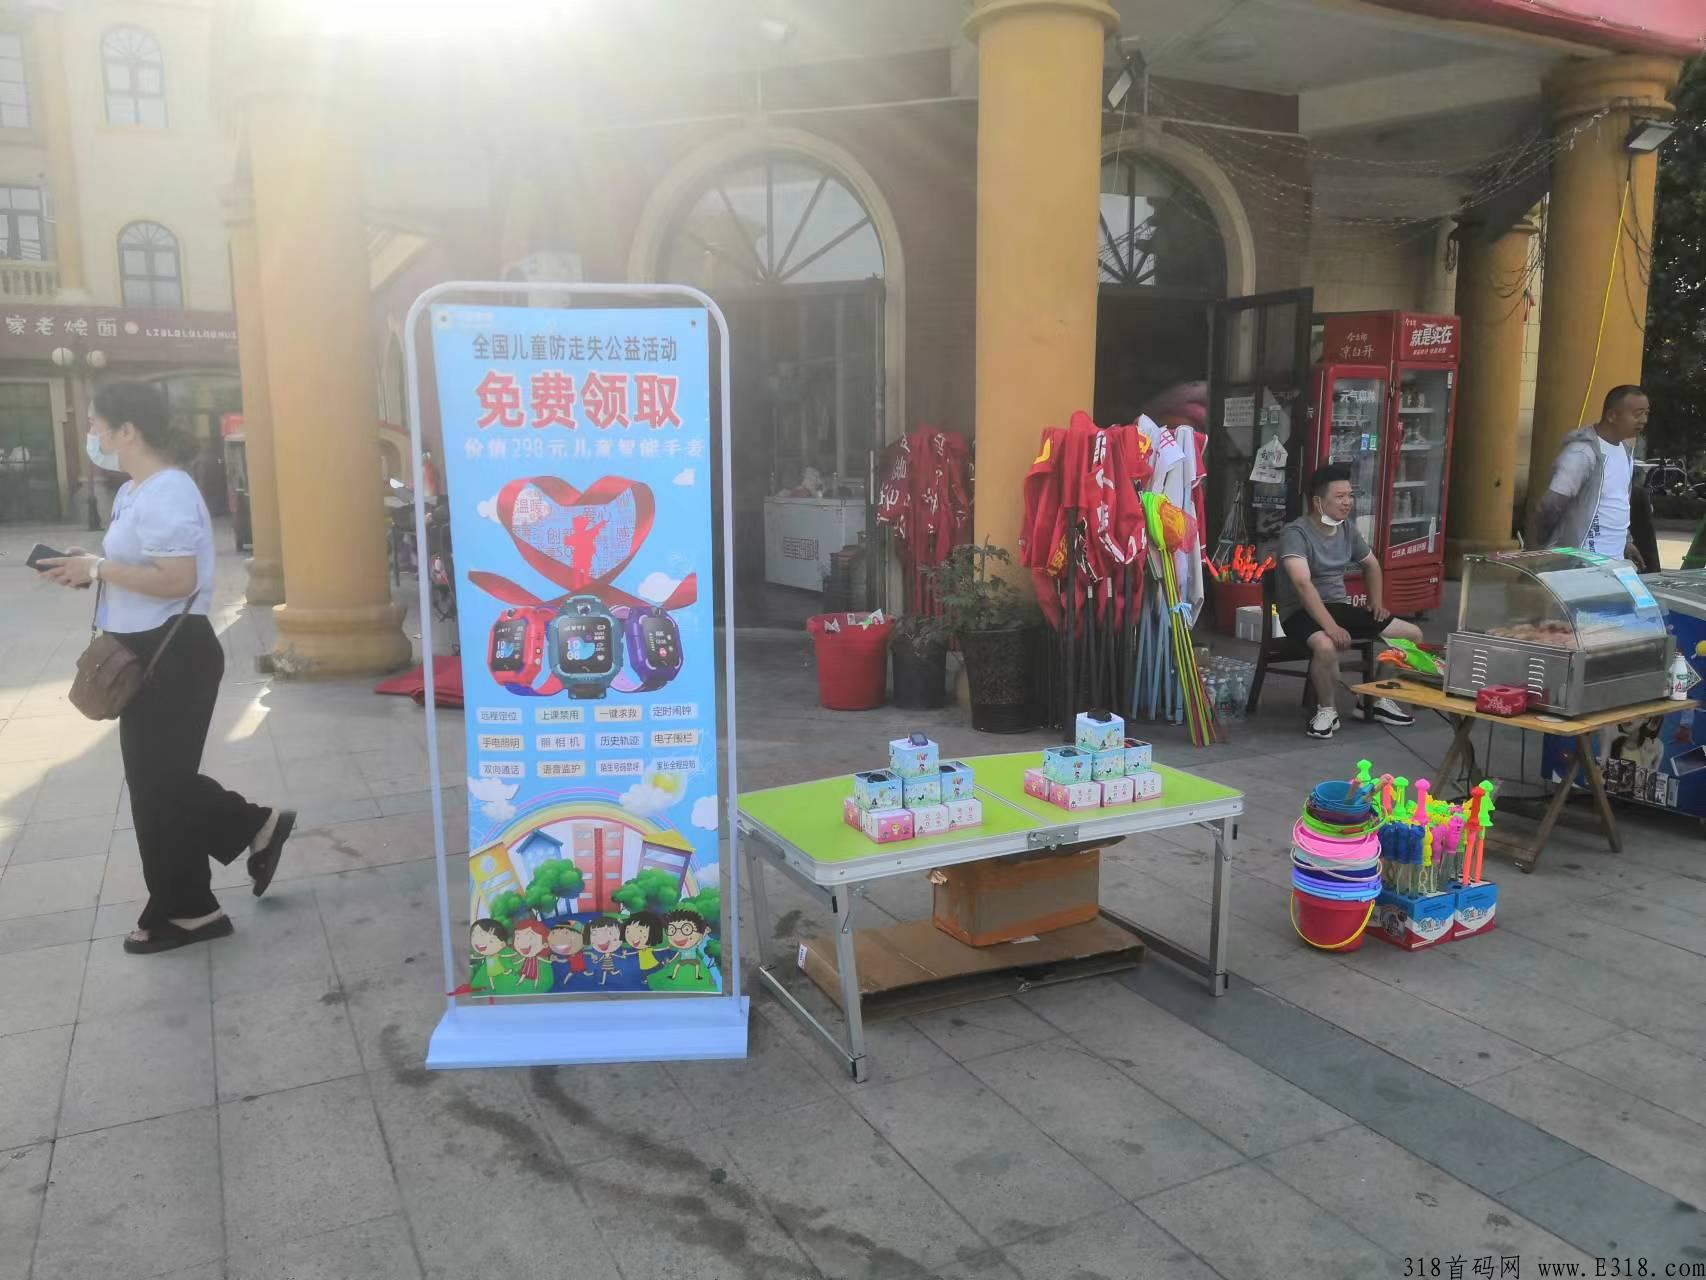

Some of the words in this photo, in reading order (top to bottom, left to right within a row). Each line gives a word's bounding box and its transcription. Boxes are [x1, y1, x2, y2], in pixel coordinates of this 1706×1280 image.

[472, 334, 678, 362] 全国儿童防走失公益活动
[474, 369, 684, 431] 免费领取
[541, 708, 579, 721] 上课禁用
[599, 706, 637, 719] 一键求救
[652, 705, 692, 717] 定时闹钟
[541, 735, 581, 748] 照相机
[600, 735, 640, 747] 历史轨迹
[654, 732, 693, 744] 电子围栏
[542, 763, 581, 775] 语音监护
